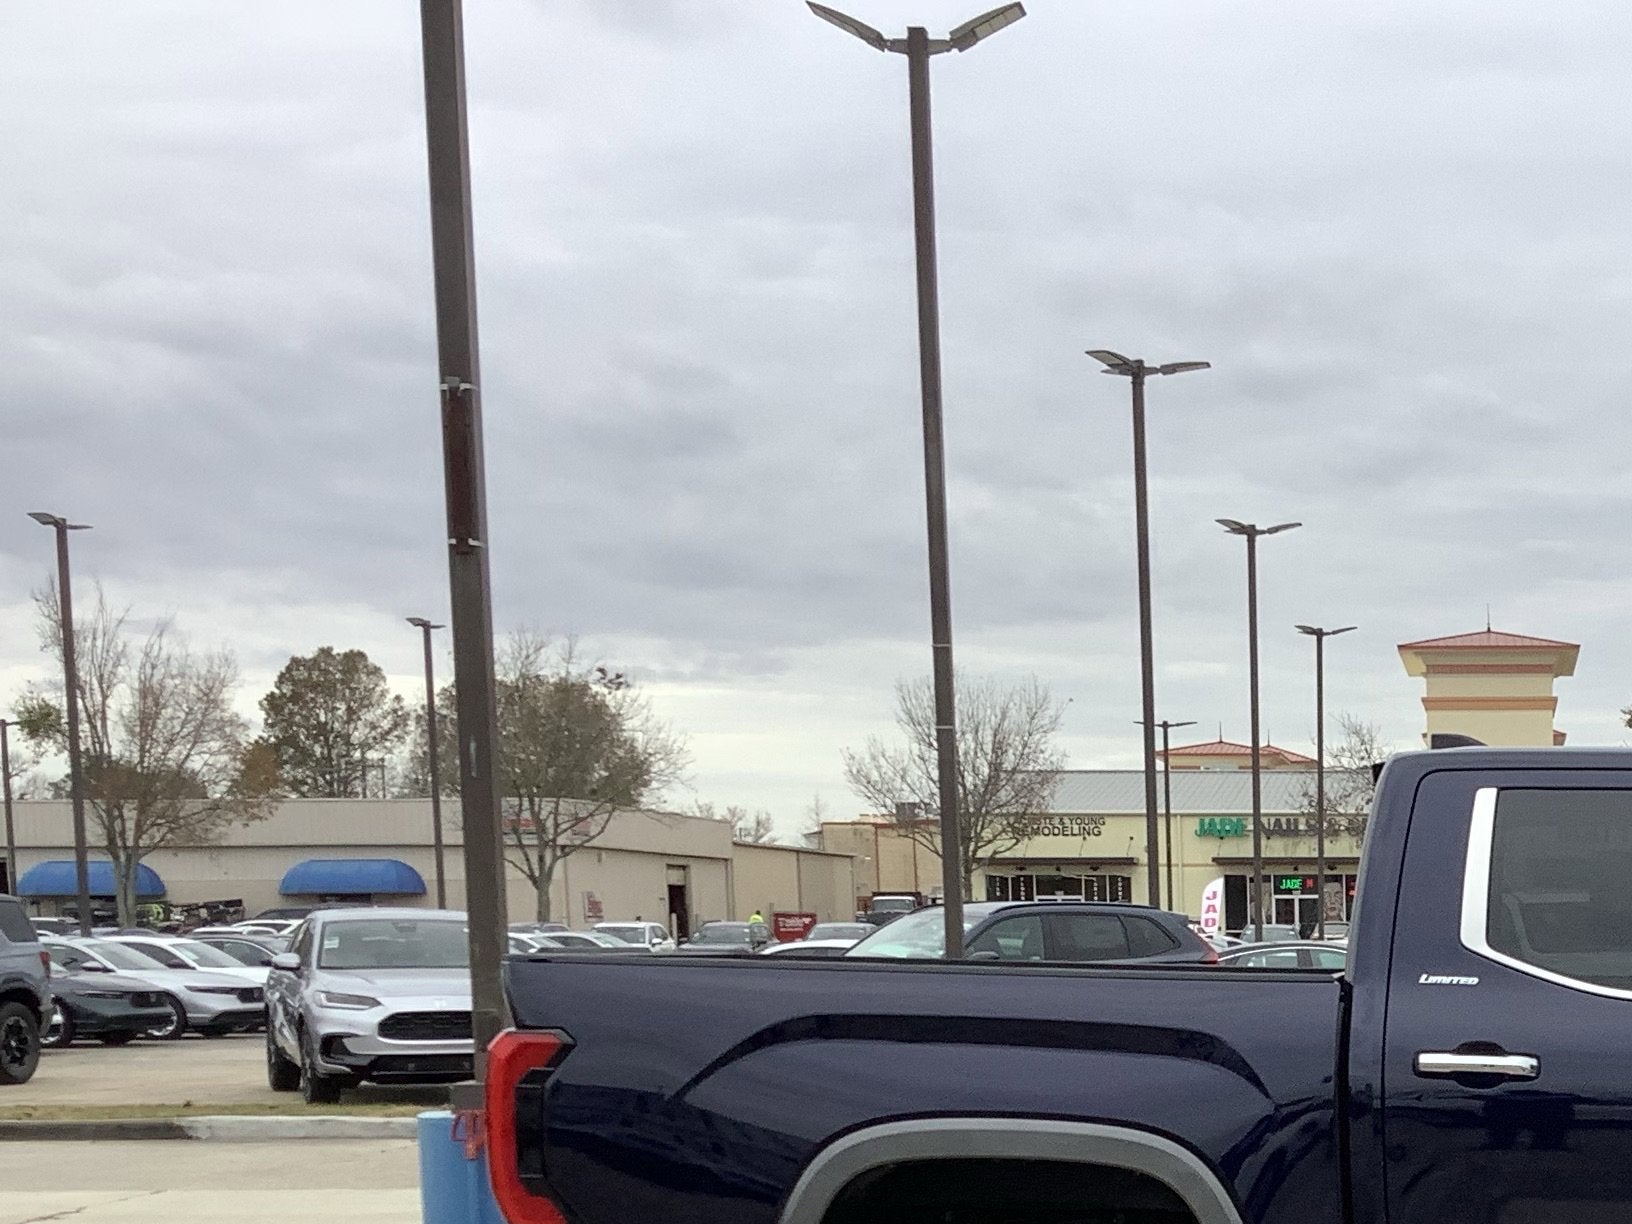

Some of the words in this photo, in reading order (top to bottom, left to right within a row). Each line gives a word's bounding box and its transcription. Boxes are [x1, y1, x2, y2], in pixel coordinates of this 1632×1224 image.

[1068, 816, 1106, 826] YOUNG
[1195, 817, 1249, 837] JADE
[1014, 825, 1102, 837] REMODELING
[1280, 878, 1303, 890] JADE
